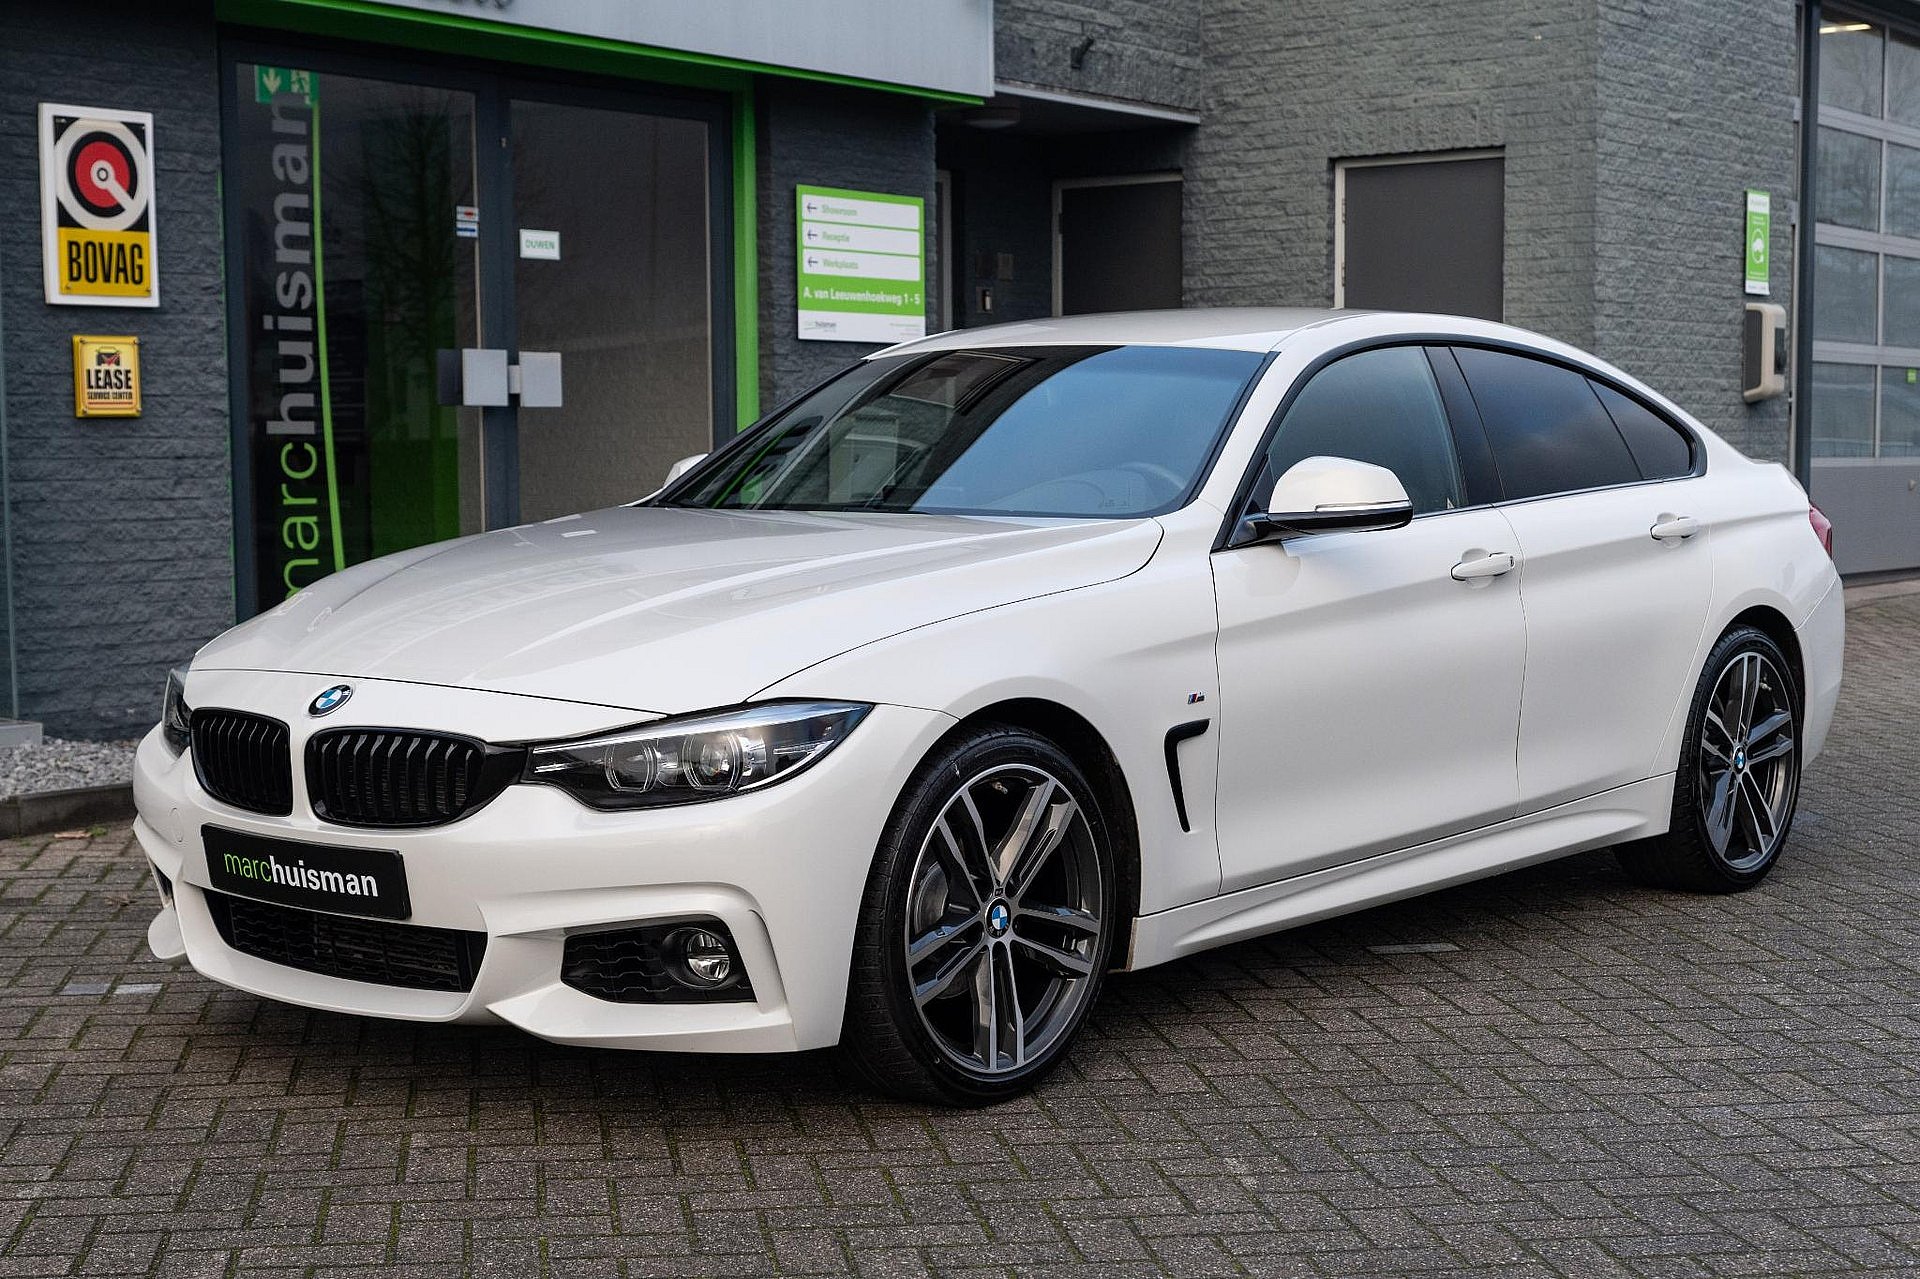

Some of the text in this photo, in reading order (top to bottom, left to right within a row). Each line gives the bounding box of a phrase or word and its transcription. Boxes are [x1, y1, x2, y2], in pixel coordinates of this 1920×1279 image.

[525, 239, 555, 250] DUWEN
[67, 240, 145, 286] BOVAG
[803, 286, 812, 299] A.
[814, 289, 829, 299] van
[904, 293, 909, 304] 1
[914, 293, 921, 305] 5
[86, 369, 132, 389] LEASE
[224, 852, 379, 897] marchuisman
